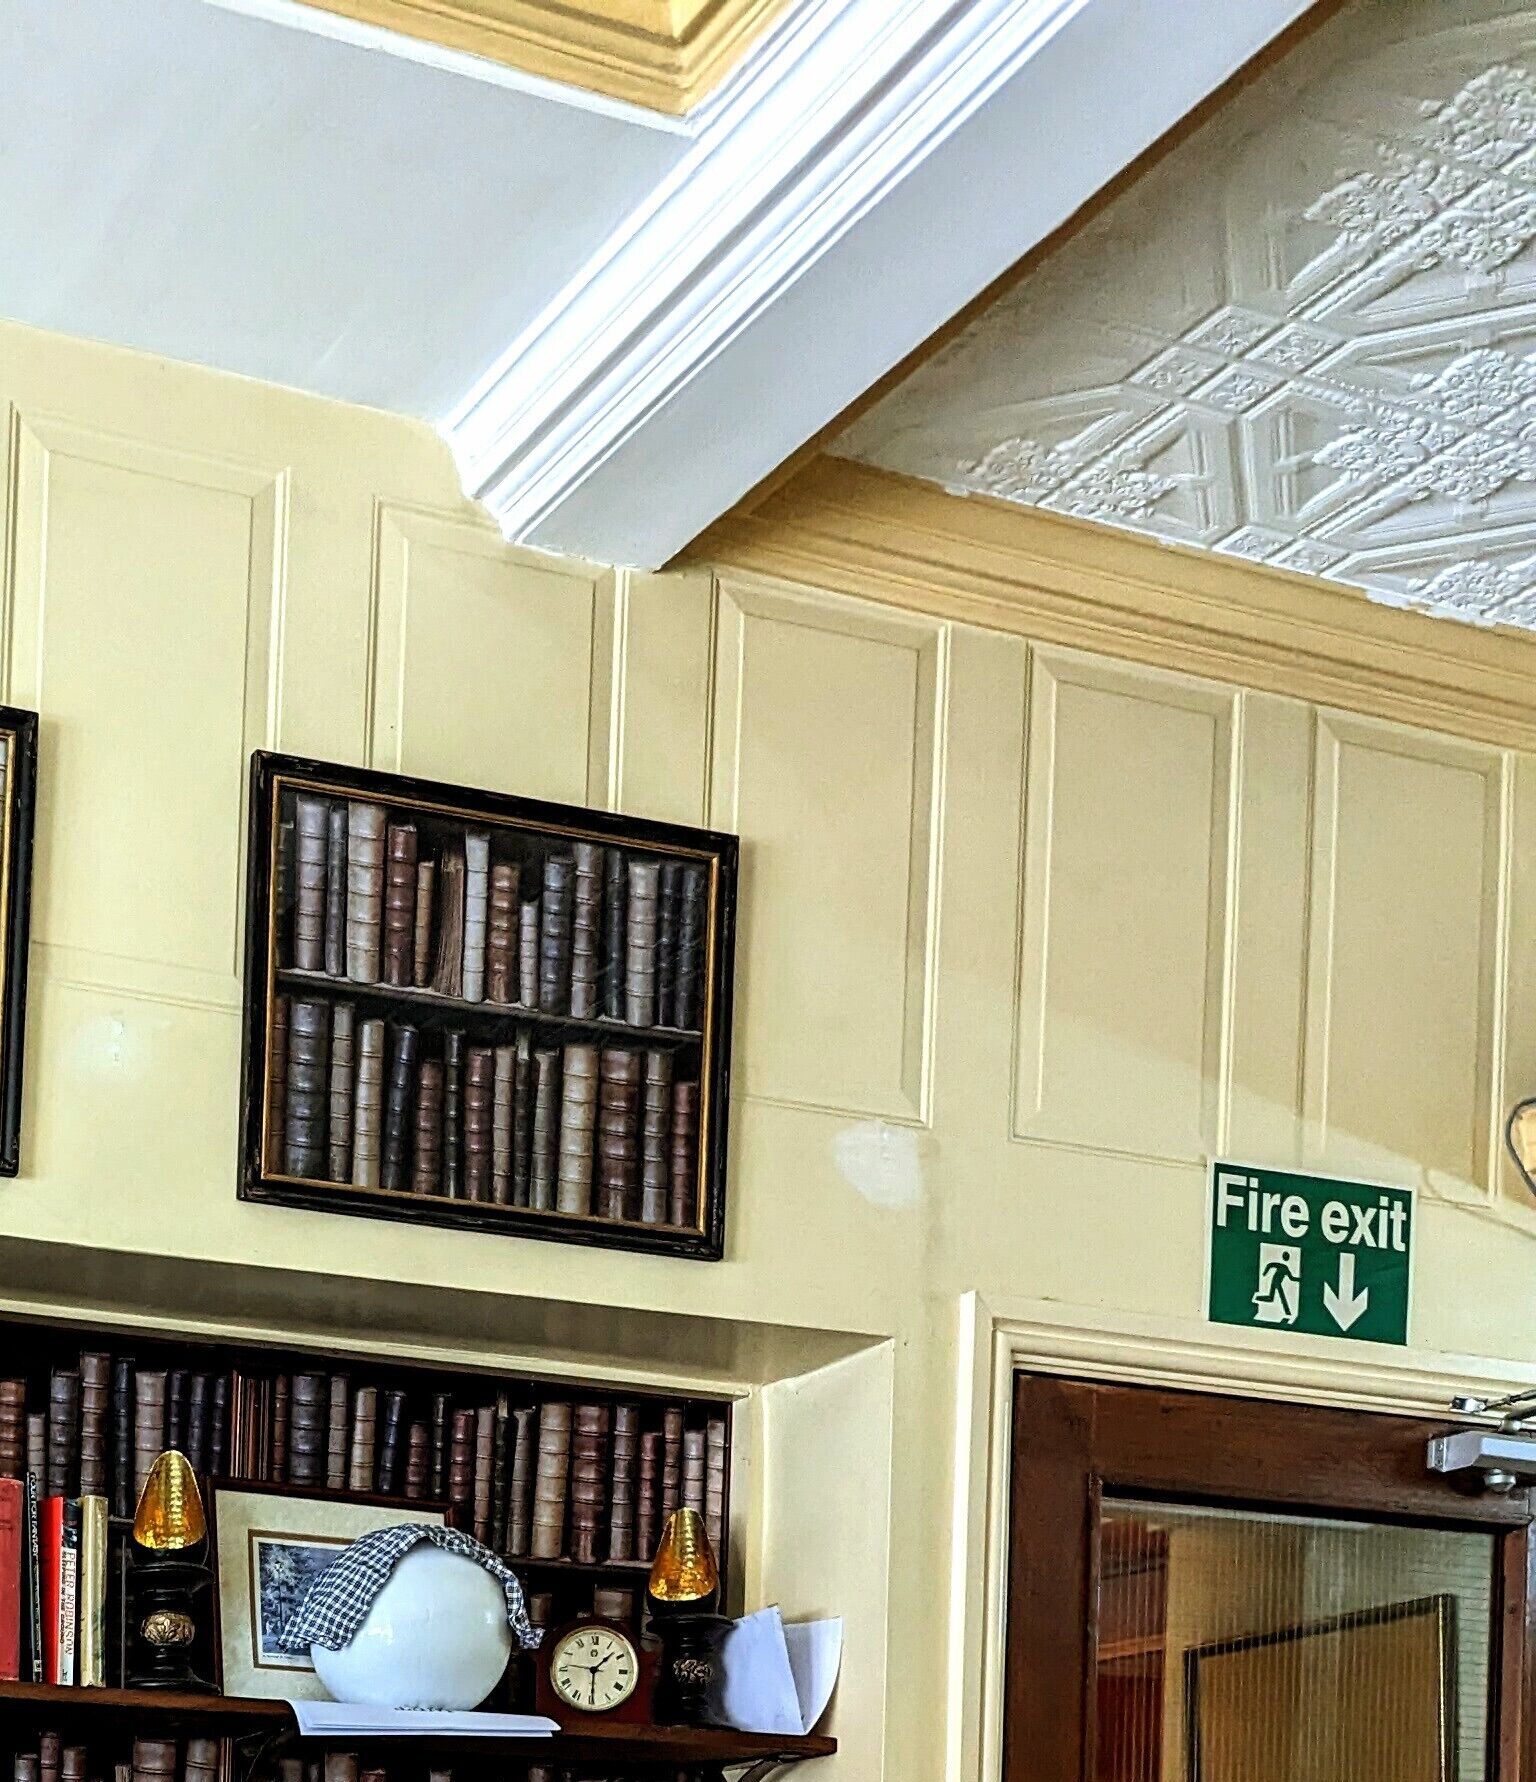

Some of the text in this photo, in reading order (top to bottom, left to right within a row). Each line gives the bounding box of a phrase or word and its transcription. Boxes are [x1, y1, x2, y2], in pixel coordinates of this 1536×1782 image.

[1217, 1172, 1407, 1252] Fire exit
[64, 1551, 76, 1656] PETER ROBINSON
